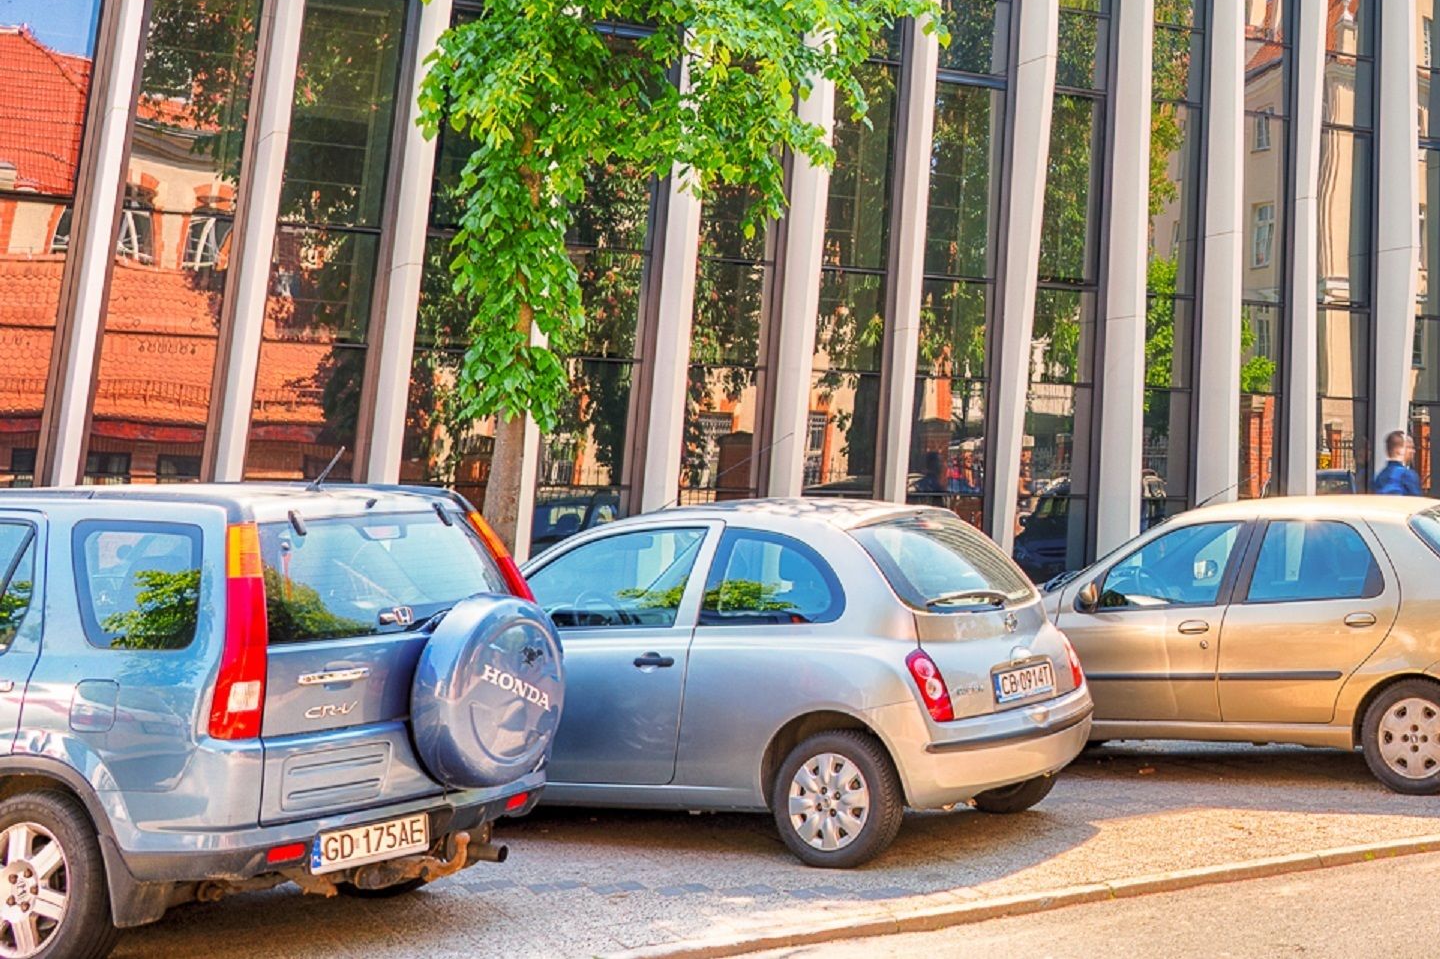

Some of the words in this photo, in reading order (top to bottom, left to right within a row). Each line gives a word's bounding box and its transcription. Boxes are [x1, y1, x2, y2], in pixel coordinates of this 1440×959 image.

[481, 664, 551, 712] HONDA
[304, 701, 358, 719] CR-V
[323, 834, 354, 861] GD
[362, 818, 424, 854] 175AE
